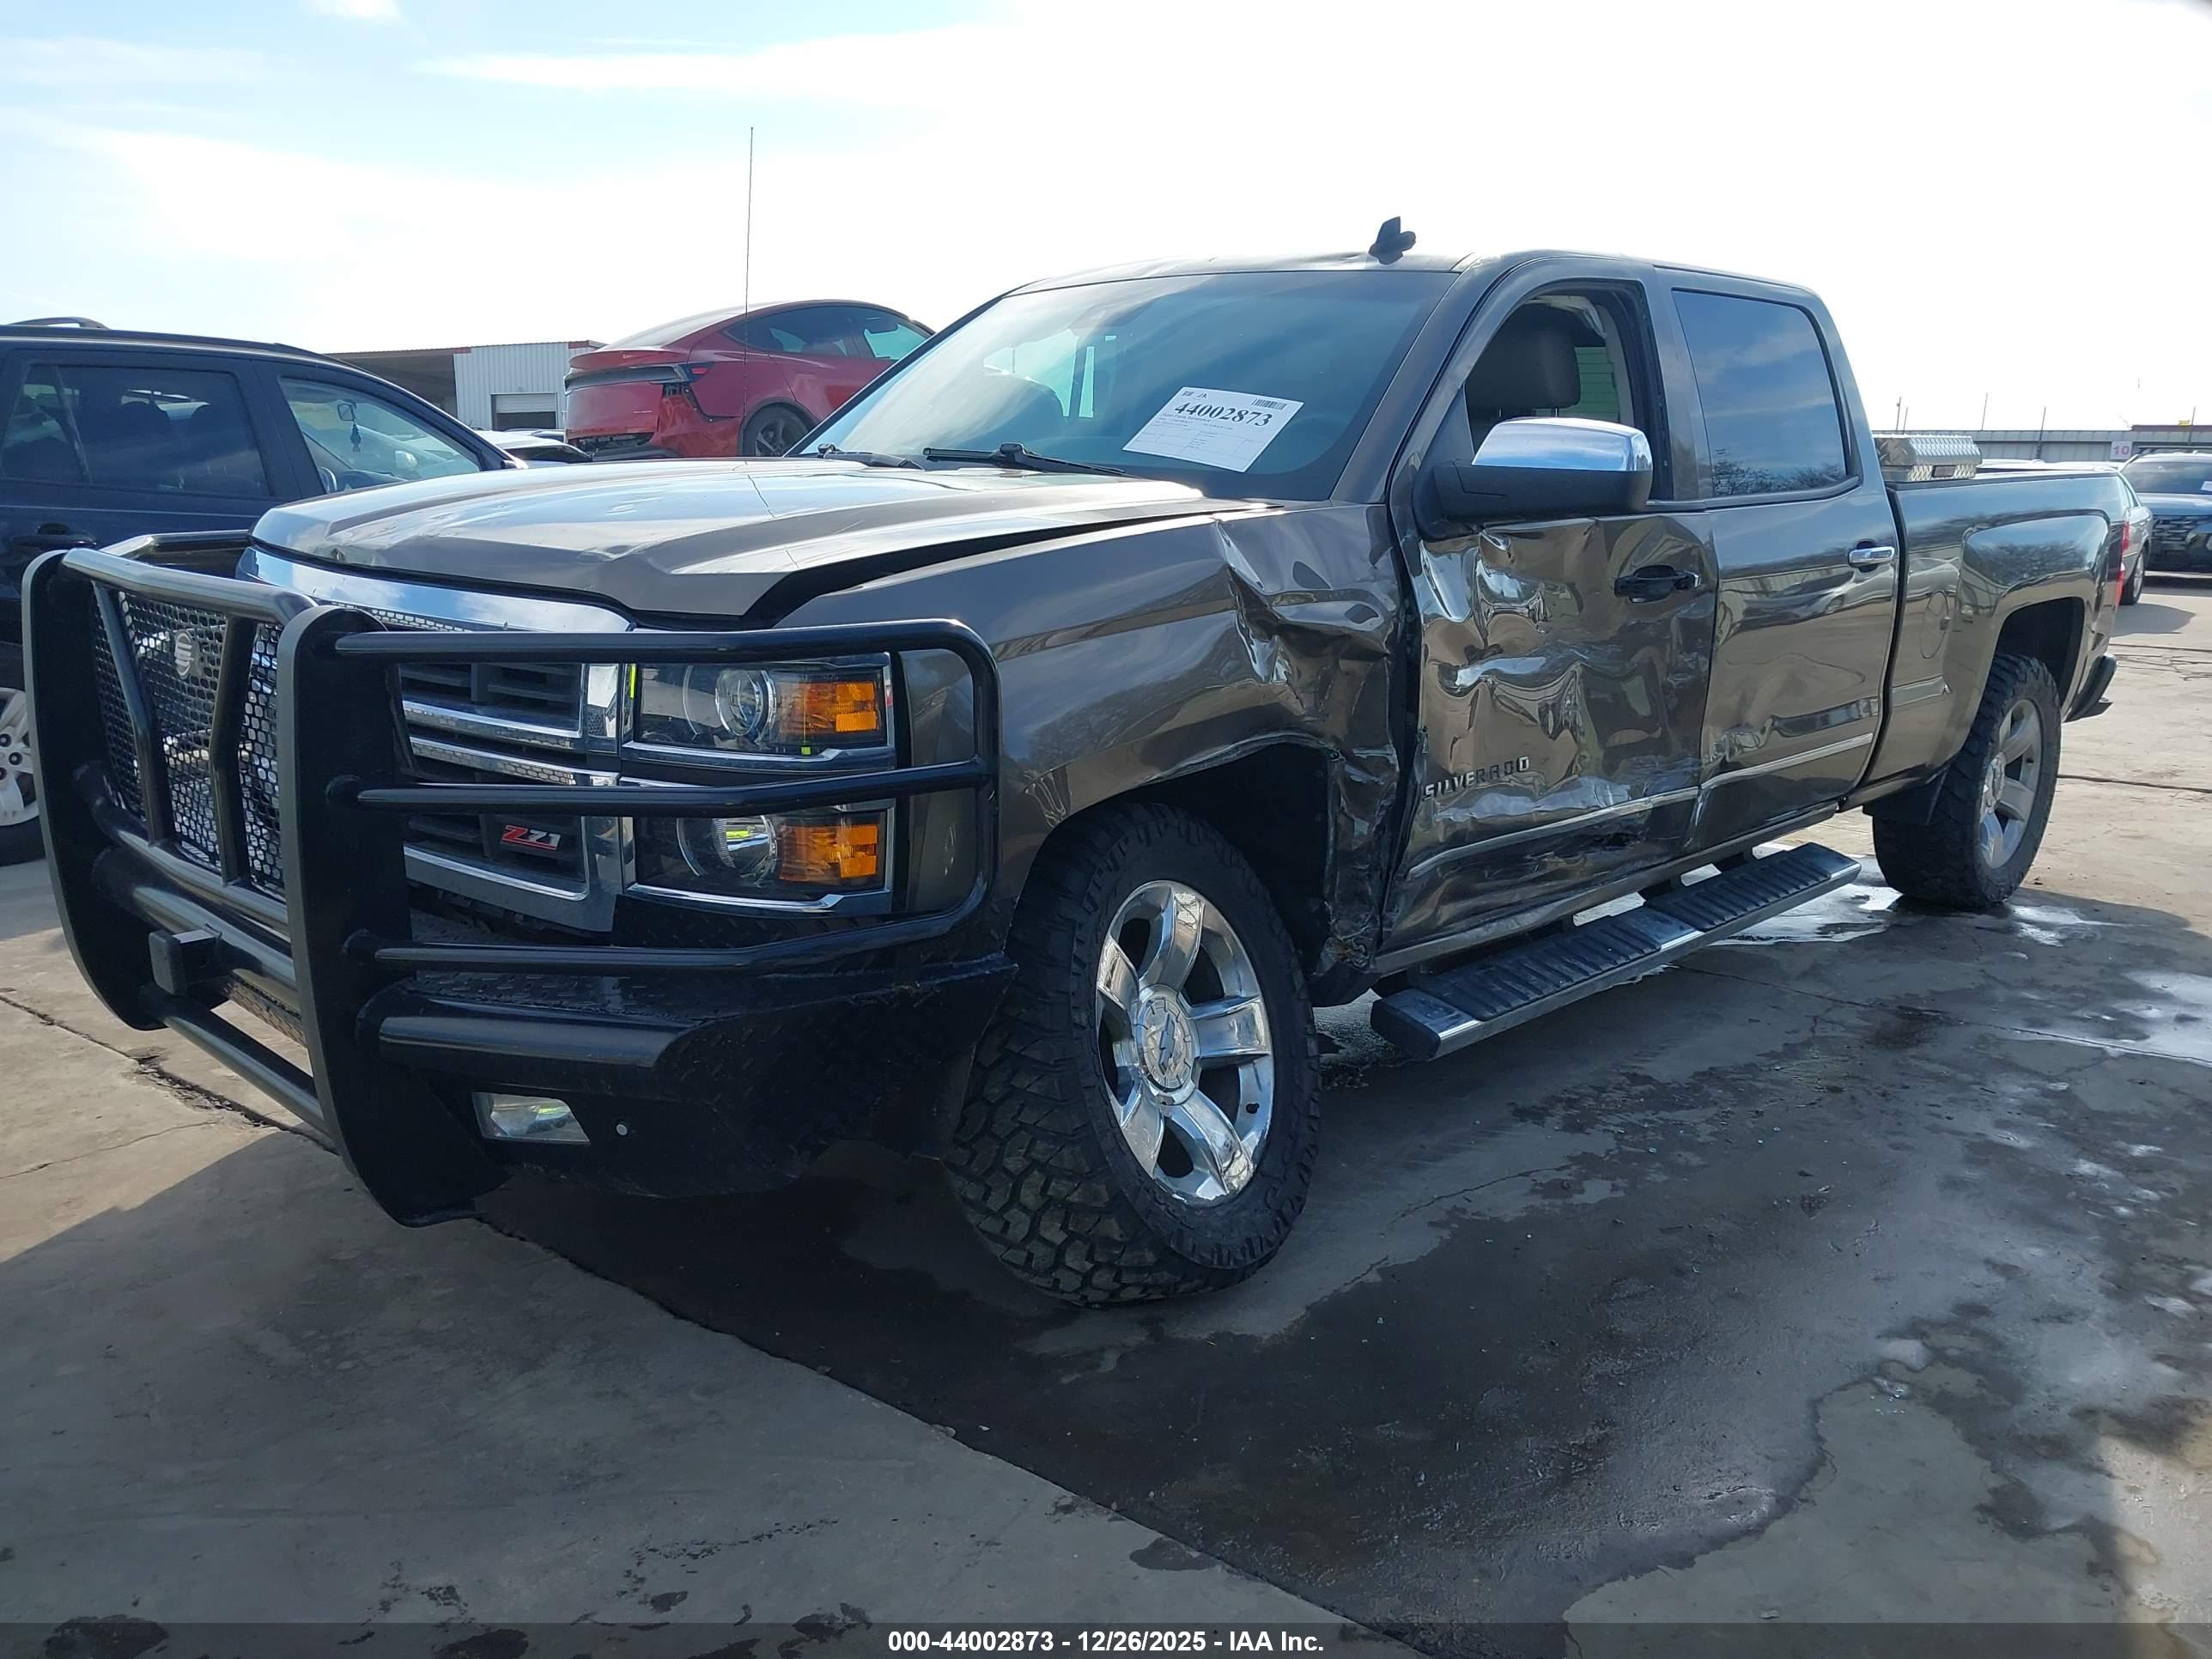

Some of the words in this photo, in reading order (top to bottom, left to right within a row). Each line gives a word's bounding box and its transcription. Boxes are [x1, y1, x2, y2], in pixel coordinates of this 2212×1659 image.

[1175, 402, 1273, 427] 44002873
[1422, 756, 1530, 800] SILVERADO
[501, 824, 562, 850] Z71
